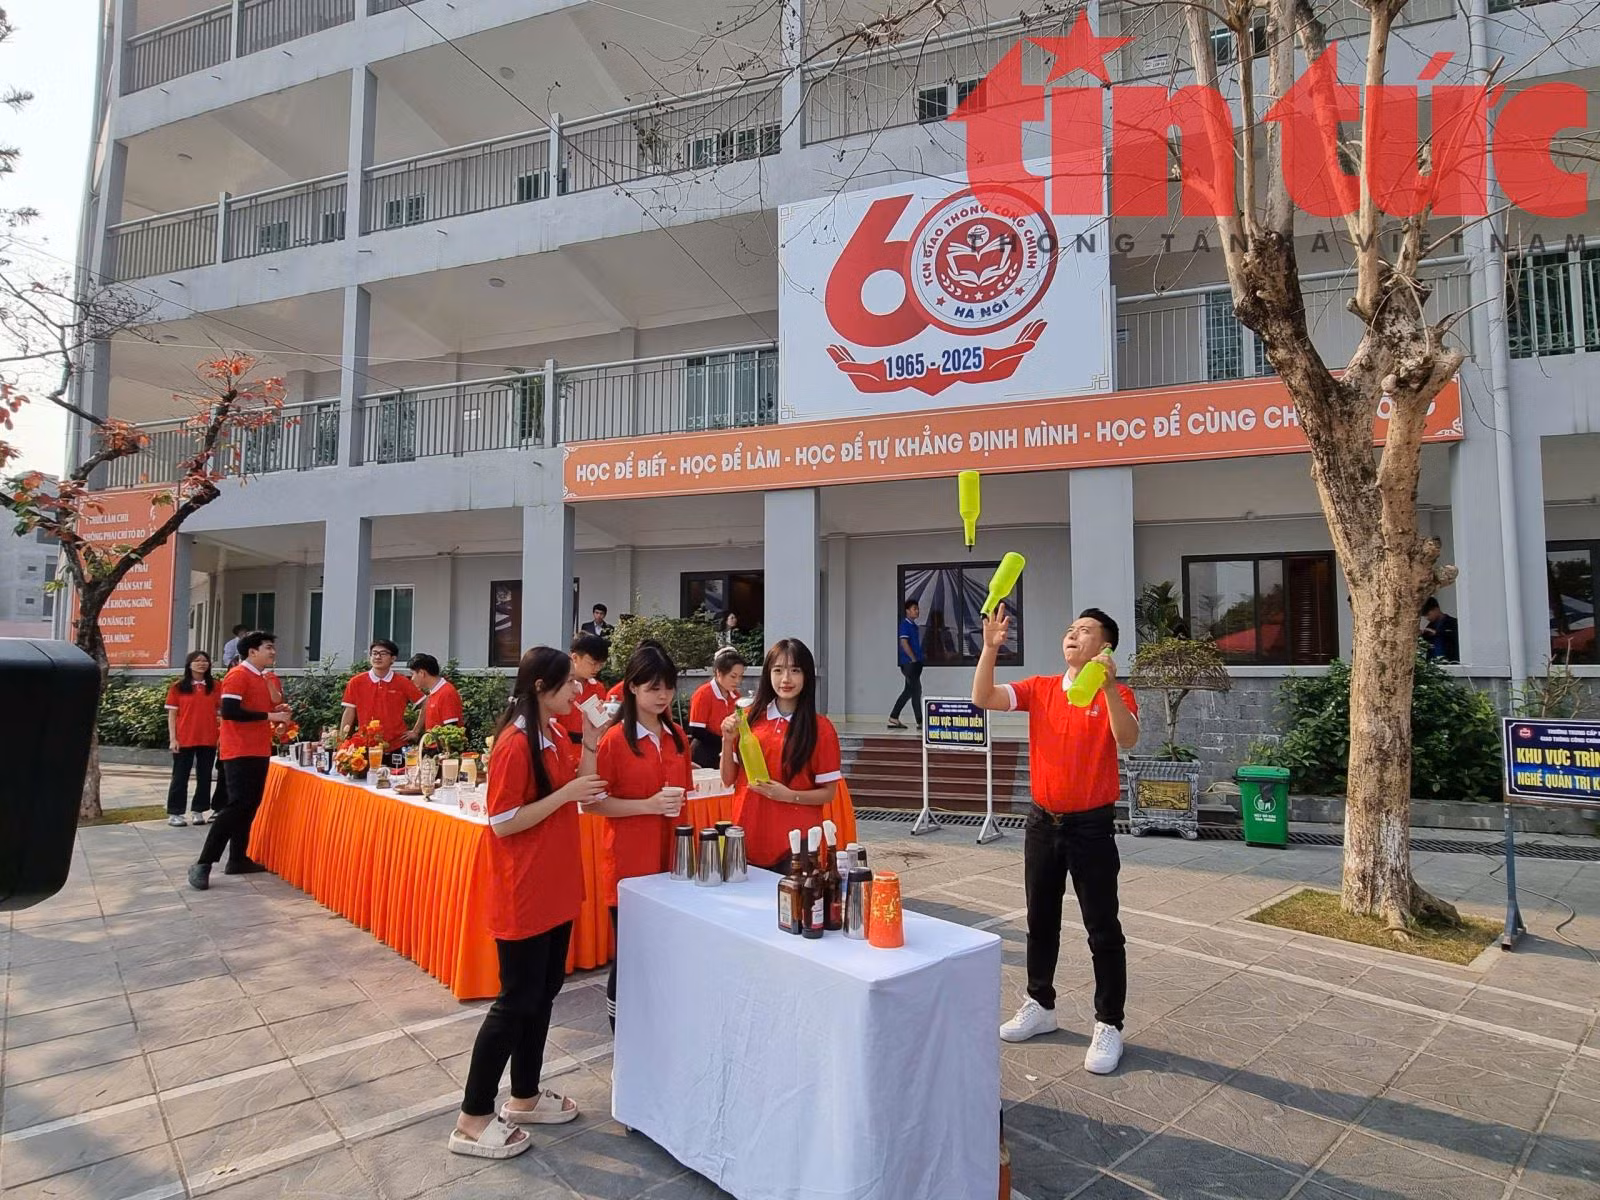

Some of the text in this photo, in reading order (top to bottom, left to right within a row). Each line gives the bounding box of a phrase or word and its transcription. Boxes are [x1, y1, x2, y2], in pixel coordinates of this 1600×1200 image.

[944, 204, 989, 227] THÔNG
[924, 228, 944, 258] GIAO
[922, 263, 933, 287] TCN
[954, 299, 1010, 319] HÀ NỘI
[886, 353, 924, 379] 1965
[941, 347, 982, 373] 2025
[576, 464, 610, 486] HỌC
[614, 451, 635, 479] ĐỂ
[637, 452, 667, 478] BIẾT
[680, 455, 717, 479] HỌC
[721, 442, 743, 472] ĐỂ
[746, 445, 781, 470] LÀM
[795, 444, 836, 470] HỌC
[841, 430, 864, 462] ĐỂ
[868, 437, 890, 465] TỰ
[895, 424, 963, 458] KHẲNG
[969, 428, 1018, 457] ĐỊNH
[1024, 420, 1078, 448] MÌNH
[1096, 418, 1146, 447] HỌC
[1153, 403, 1182, 438] ĐỂ
[1187, 406, 1257, 434] CÙNG
[1516, 747, 1600, 769] KHU VỰC TRÌN
[1545, 770, 1572, 789] QUẢN
[1574, 775, 1591, 793] TRỊ
